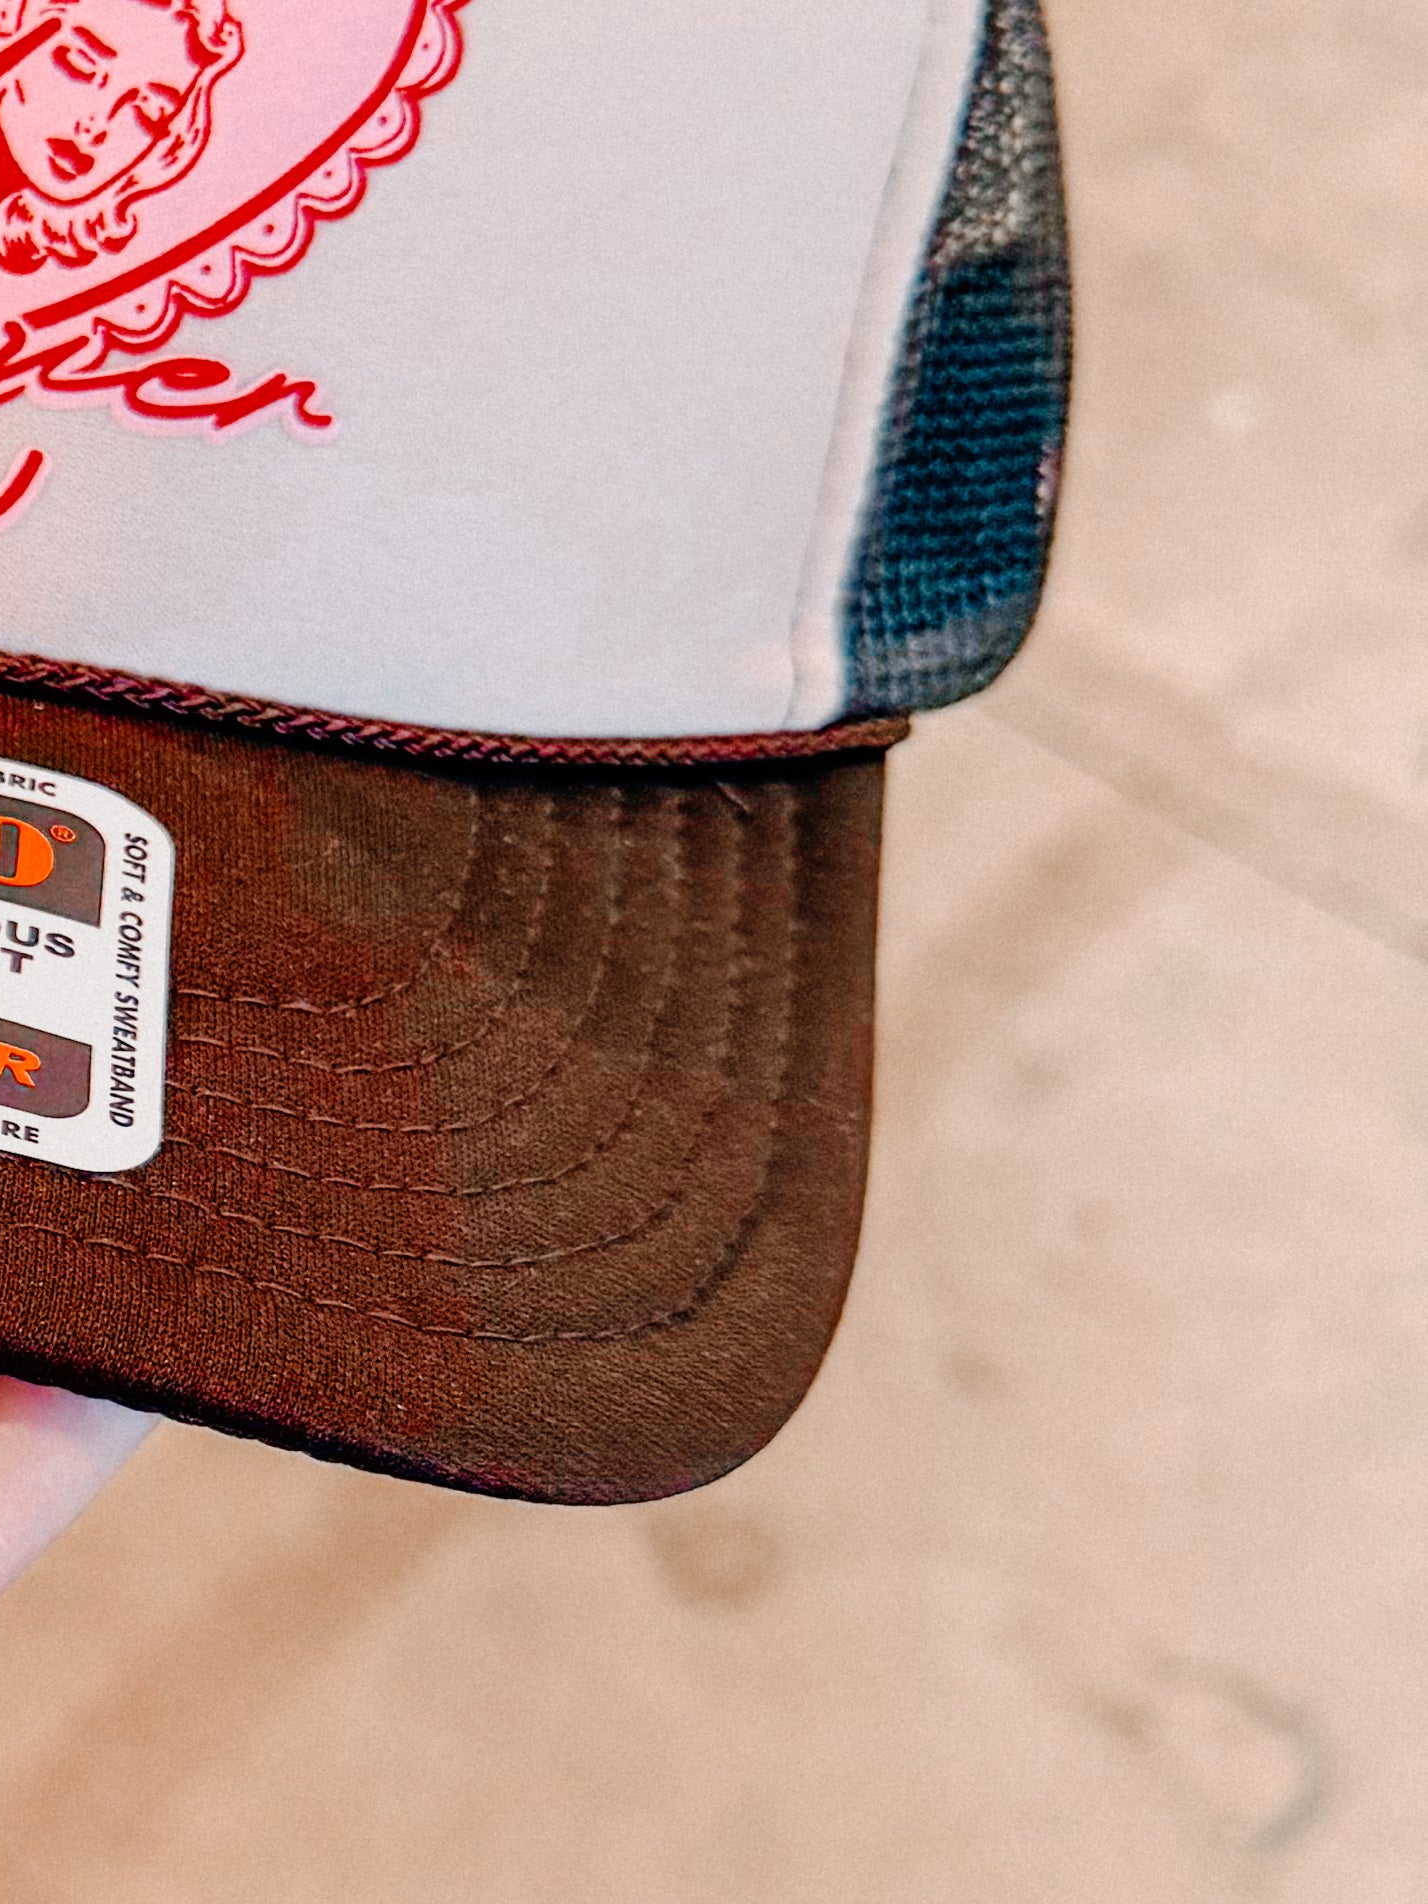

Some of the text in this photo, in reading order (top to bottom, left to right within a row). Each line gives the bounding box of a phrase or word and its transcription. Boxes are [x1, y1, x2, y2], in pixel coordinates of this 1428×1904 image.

[109, 832, 149, 1129] SOFT & COMFY SWEATBAND
